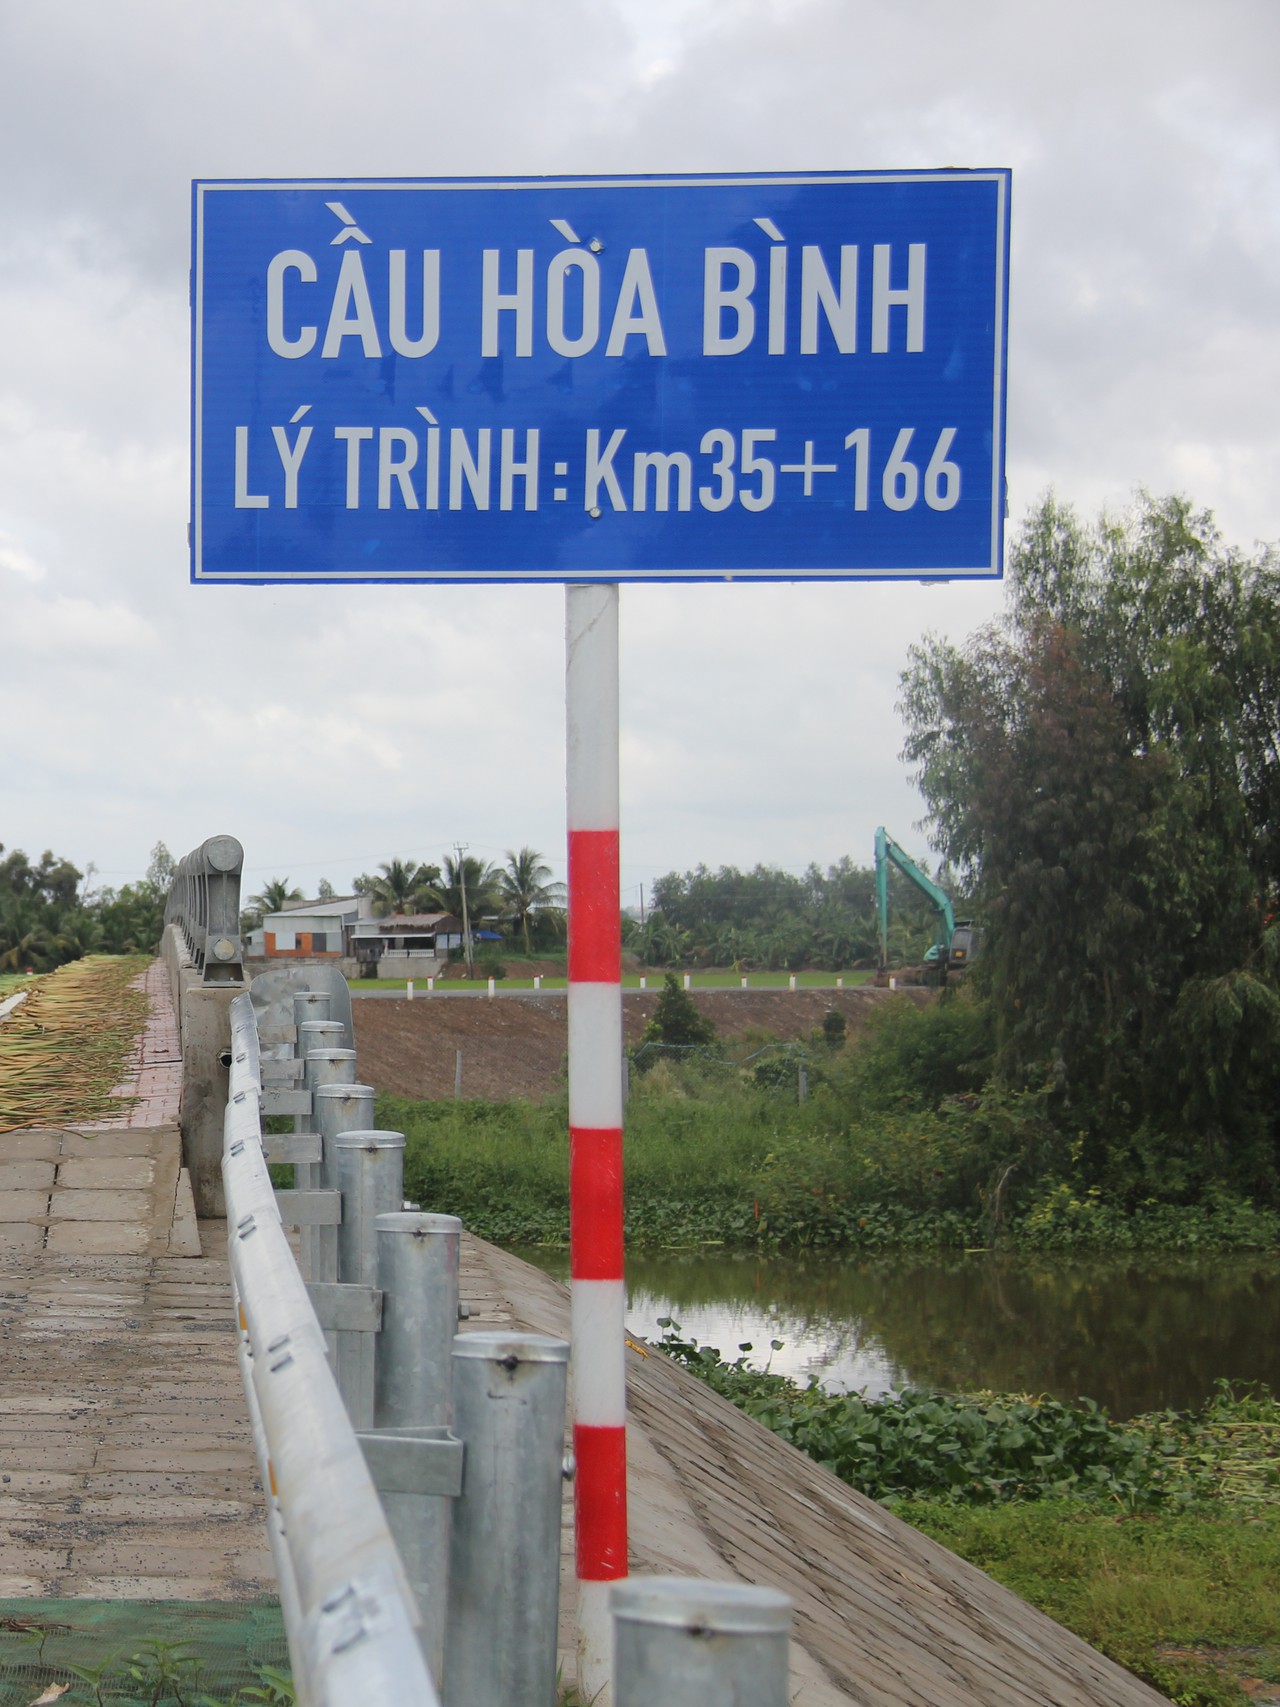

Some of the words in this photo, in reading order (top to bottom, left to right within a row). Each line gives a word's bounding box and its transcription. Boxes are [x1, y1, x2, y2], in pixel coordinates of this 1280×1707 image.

[265, 202, 441, 360] CẦU
[481, 219, 667, 358] HÒA
[703, 217, 926, 357] BÌNH
[234, 405, 313, 510] LÝ
